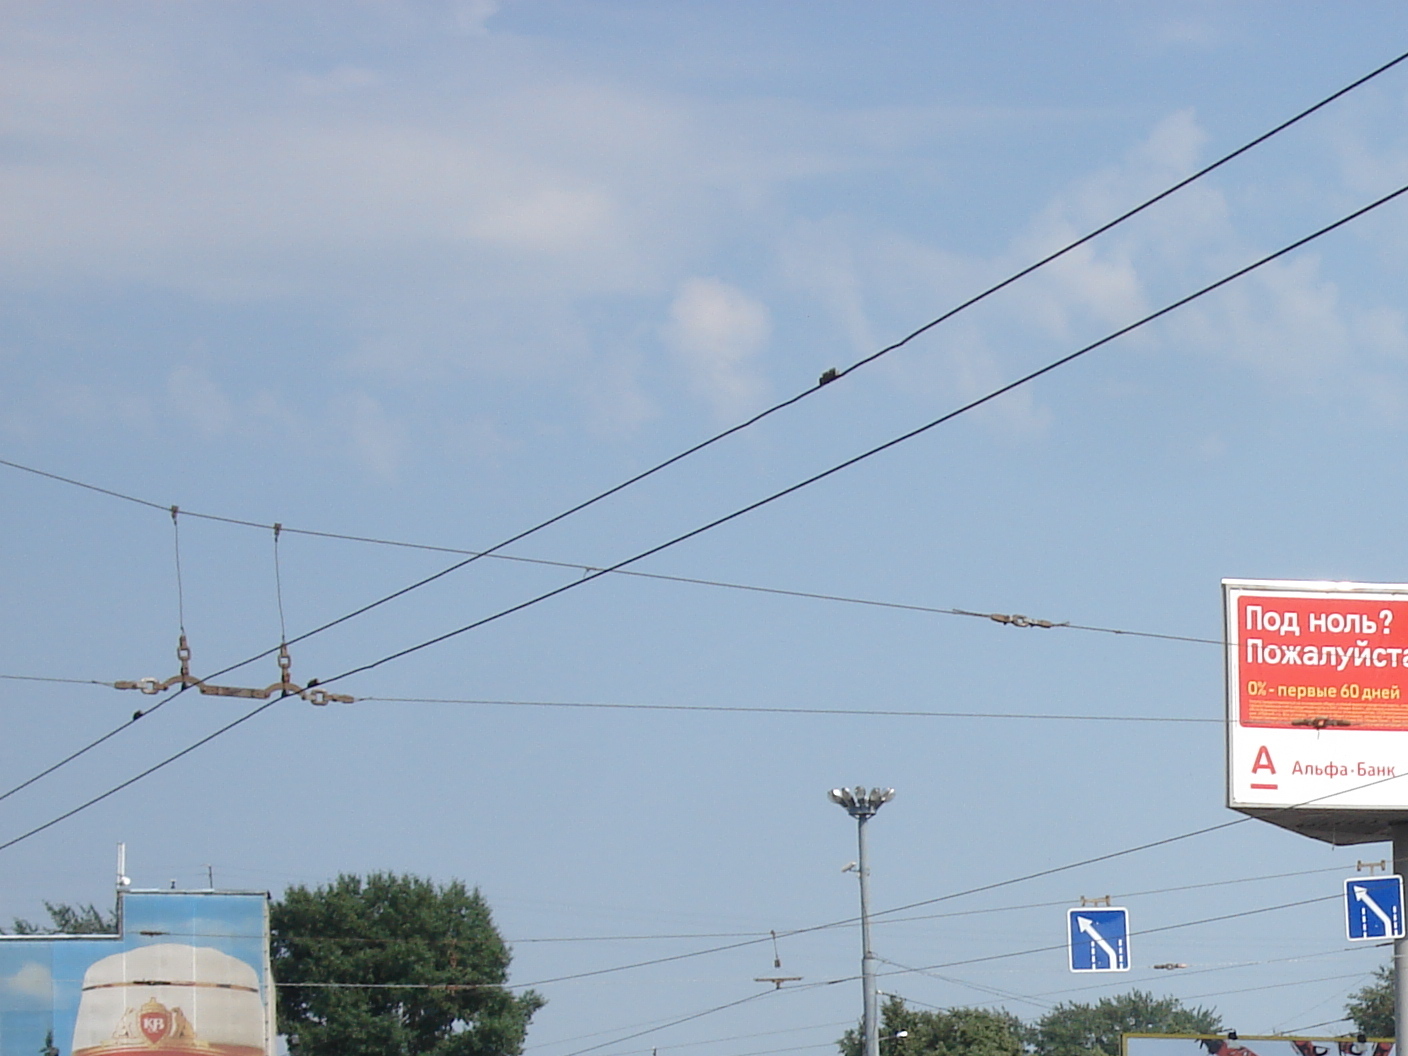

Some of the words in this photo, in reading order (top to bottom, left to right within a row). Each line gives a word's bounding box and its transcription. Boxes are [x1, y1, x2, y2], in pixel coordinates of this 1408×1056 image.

[1246, 605, 1300, 636] Под
[1309, 610, 1393, 634] ноль?
[1277, 685, 1337, 700] первые
[1340, 684, 1360, 698] 60
[1361, 685, 1401, 701] дней
